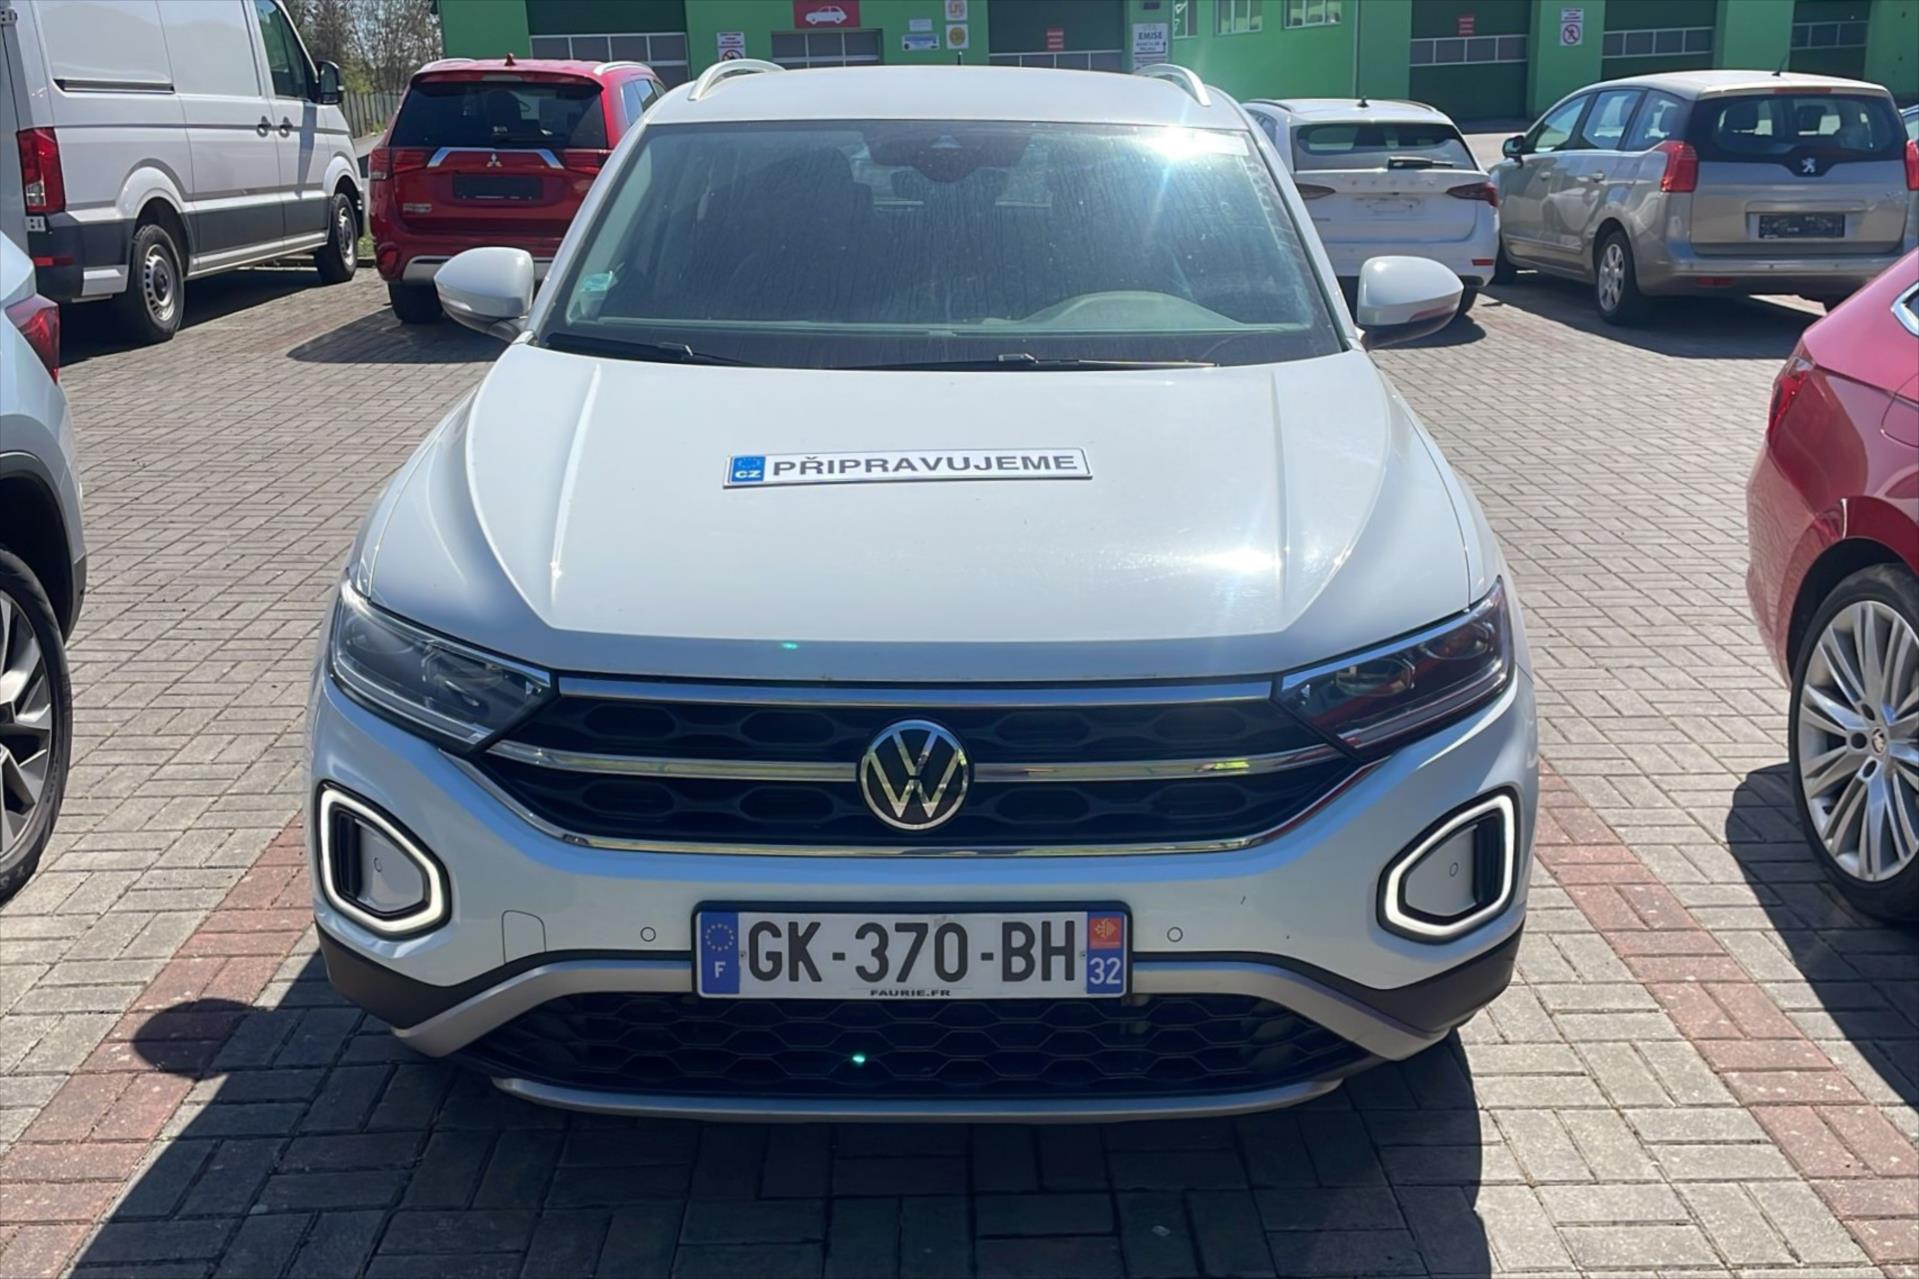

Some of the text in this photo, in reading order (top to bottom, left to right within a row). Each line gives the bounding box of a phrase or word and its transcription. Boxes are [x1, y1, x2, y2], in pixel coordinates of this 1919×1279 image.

[735, 469, 761, 479] CZ
[773, 455, 1078, 476] PŘIPRAVUJEME
[749, 920, 1075, 984] GK-370-BH
[714, 961, 726, 979] F
[1089, 957, 1121, 985] 32
[870, 989, 951, 997] FAURIE.FR
